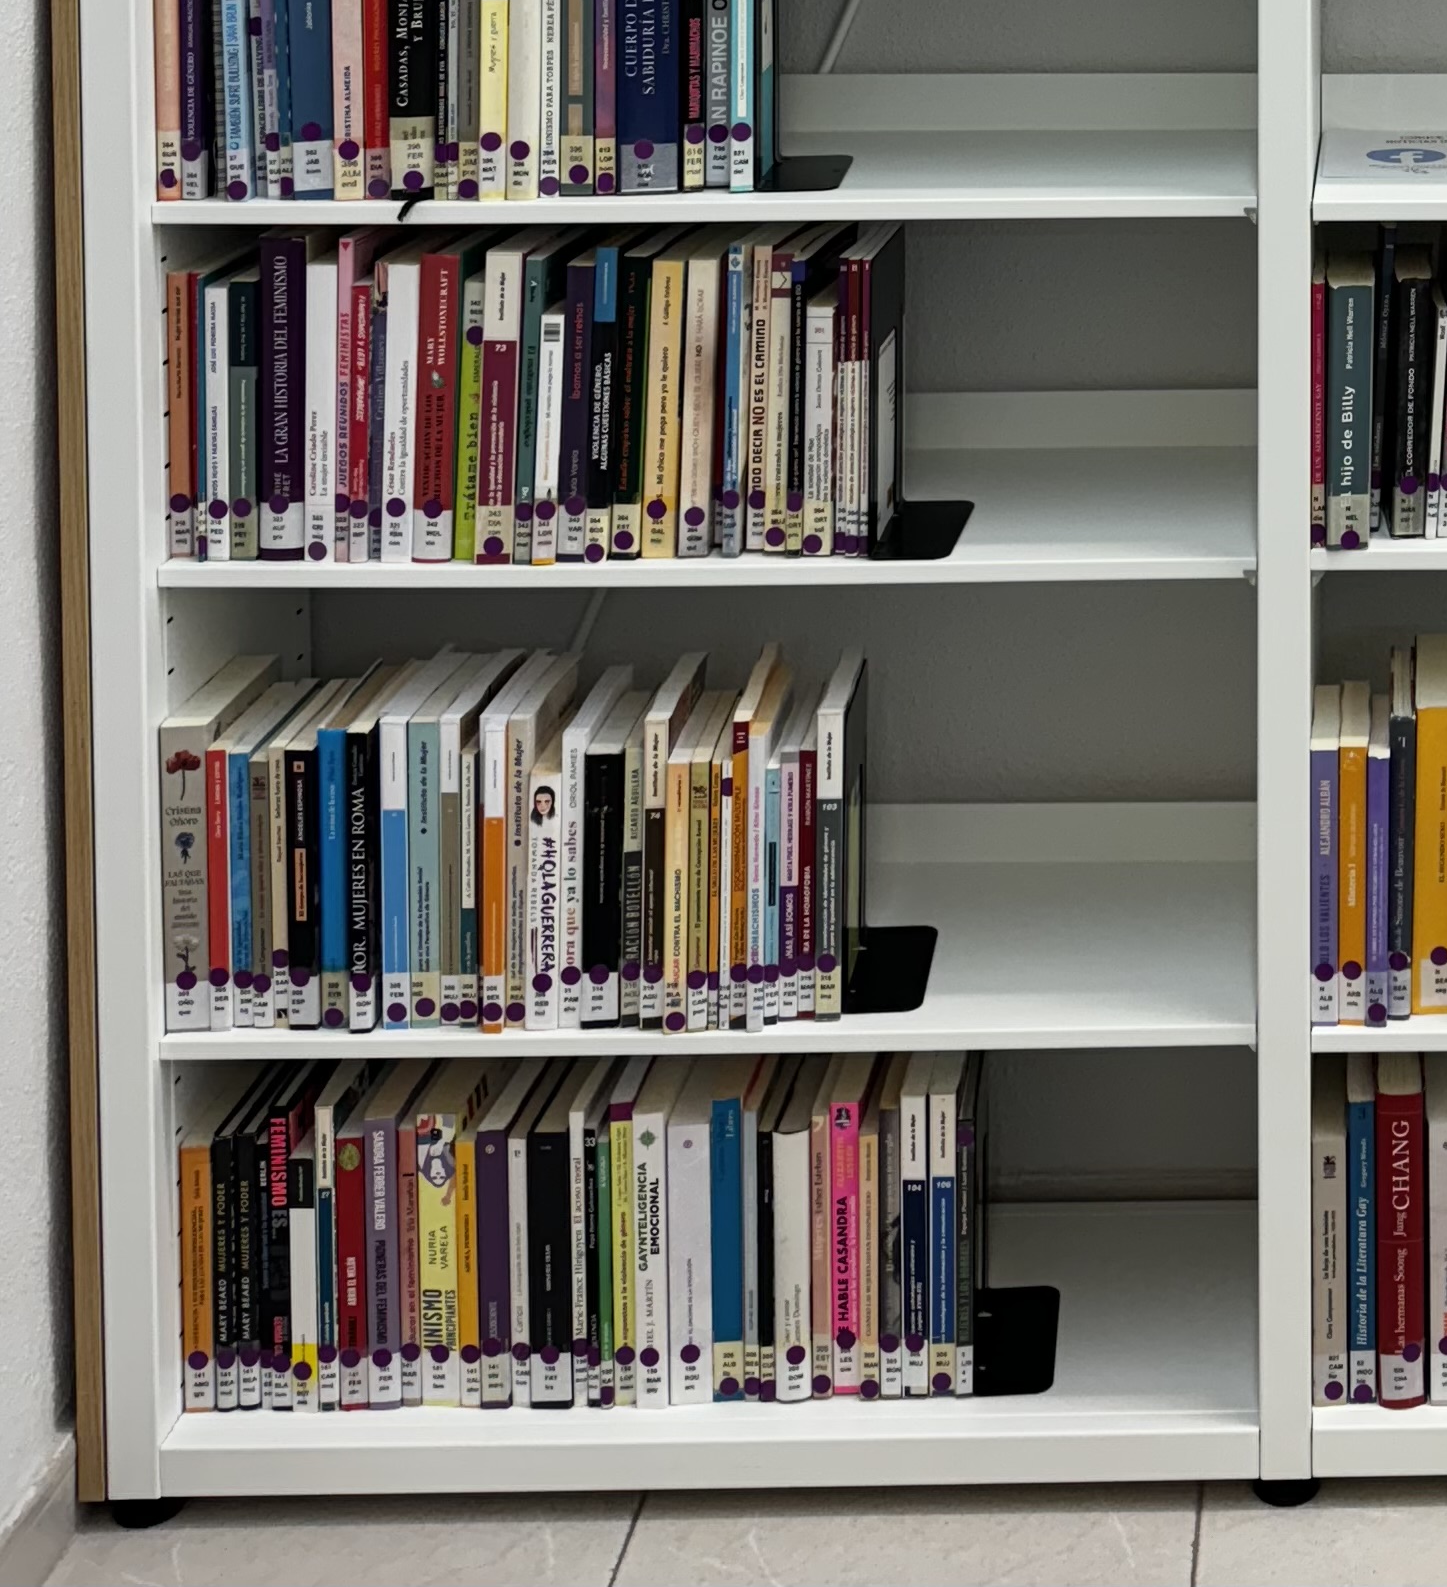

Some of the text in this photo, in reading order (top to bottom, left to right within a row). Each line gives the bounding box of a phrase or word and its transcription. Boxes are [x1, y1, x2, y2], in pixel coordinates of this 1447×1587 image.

[396, 45, 410, 107] CASADAS,
[413, 34, 421, 42] Y
[624, 13, 638, 77] CUERPO
[638, 9, 655, 95] SABIDURÍA
[712, 17, 727, 100] RAPINOE
[273, 255, 289, 463] LA GRAN HISTORIA DEL FEMINISMO
[463, 412, 478, 521] Trátame bien
[1341, 386, 1356, 486] hijo de Billy
[351, 787, 368, 930] MUJERES EN ROMA
[538, 837, 557, 973] #HOLAGUERRERA
[562, 821, 579, 935] que ya lo sabes
[624, 865, 641, 917] BOTELLÓN
[269, 1117, 287, 1207] FEMINISMO
[372, 1131, 386, 1231] SANDRA FERRER VALERO
[1392, 1120, 1410, 1237] Jung CHANG
[427, 1230, 437, 1265] NURIA
[438, 1225, 449, 1270] VARELA
[637, 1162, 649, 1271] GAYNTELIGENCIA
[649, 1178, 660, 1255] EMOCIONAL
[836, 1197, 849, 1322] HABLE CASANDRA
